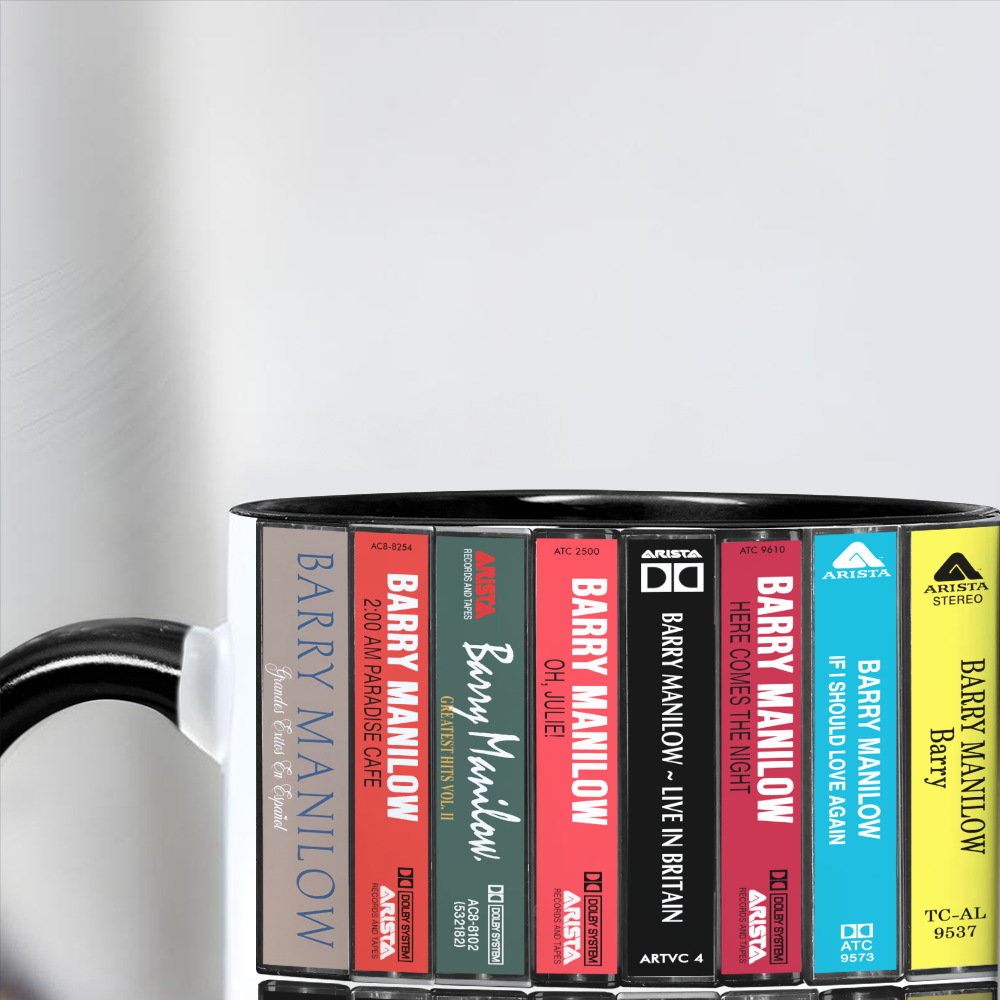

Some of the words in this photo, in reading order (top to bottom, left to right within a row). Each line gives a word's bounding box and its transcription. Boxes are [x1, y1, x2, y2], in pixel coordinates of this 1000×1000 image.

[371, 543, 412, 551] AC8-8254
[554, 547, 572, 555] ATC
[924, 582, 989, 593] ARISTA
[933, 594, 983, 606] STEREO
[297, 553, 334, 690] BARRY
[364, 599, 381, 630] 2:00
[572, 578, 607, 675] BARRY
[730, 602, 750, 643] HERE
[364, 636, 381, 659] AM
[662, 613, 683, 668] BARRY
[829, 656, 845, 669] IF
[448, 642, 514, 724] Barry
[541, 659, 565, 685] OH,
[730, 649, 751, 705] COMES
[364, 665, 382, 741] PARADISE
[544, 691, 565, 737] JULIE!
[661, 674, 683, 765] MANILOW
[730, 710, 750, 740] THE
[829, 682, 846, 746] SHOULD
[364, 747, 381, 787] CAFE
[572, 686, 608, 825] MANILOW
[730, 746, 751, 794] NIGHT
[829, 750, 846, 791] LOVE
[924, 727, 954, 788] Barry
[662, 787, 683, 822] LIVE
[829, 795, 846, 845] AGAIN
[296, 707, 335, 948] MANILOW
[662, 829, 683, 846] IN
[662, 854, 683, 922] BRITAIN
[454, 902, 465, 947] (532182)
[468, 899, 479, 951] AC8-8102
[563, 891, 581, 965] ARISTA
[841, 940, 872, 951] ATC
[934, 925, 976, 939] 9537
[841, 953, 874, 962] 9573
